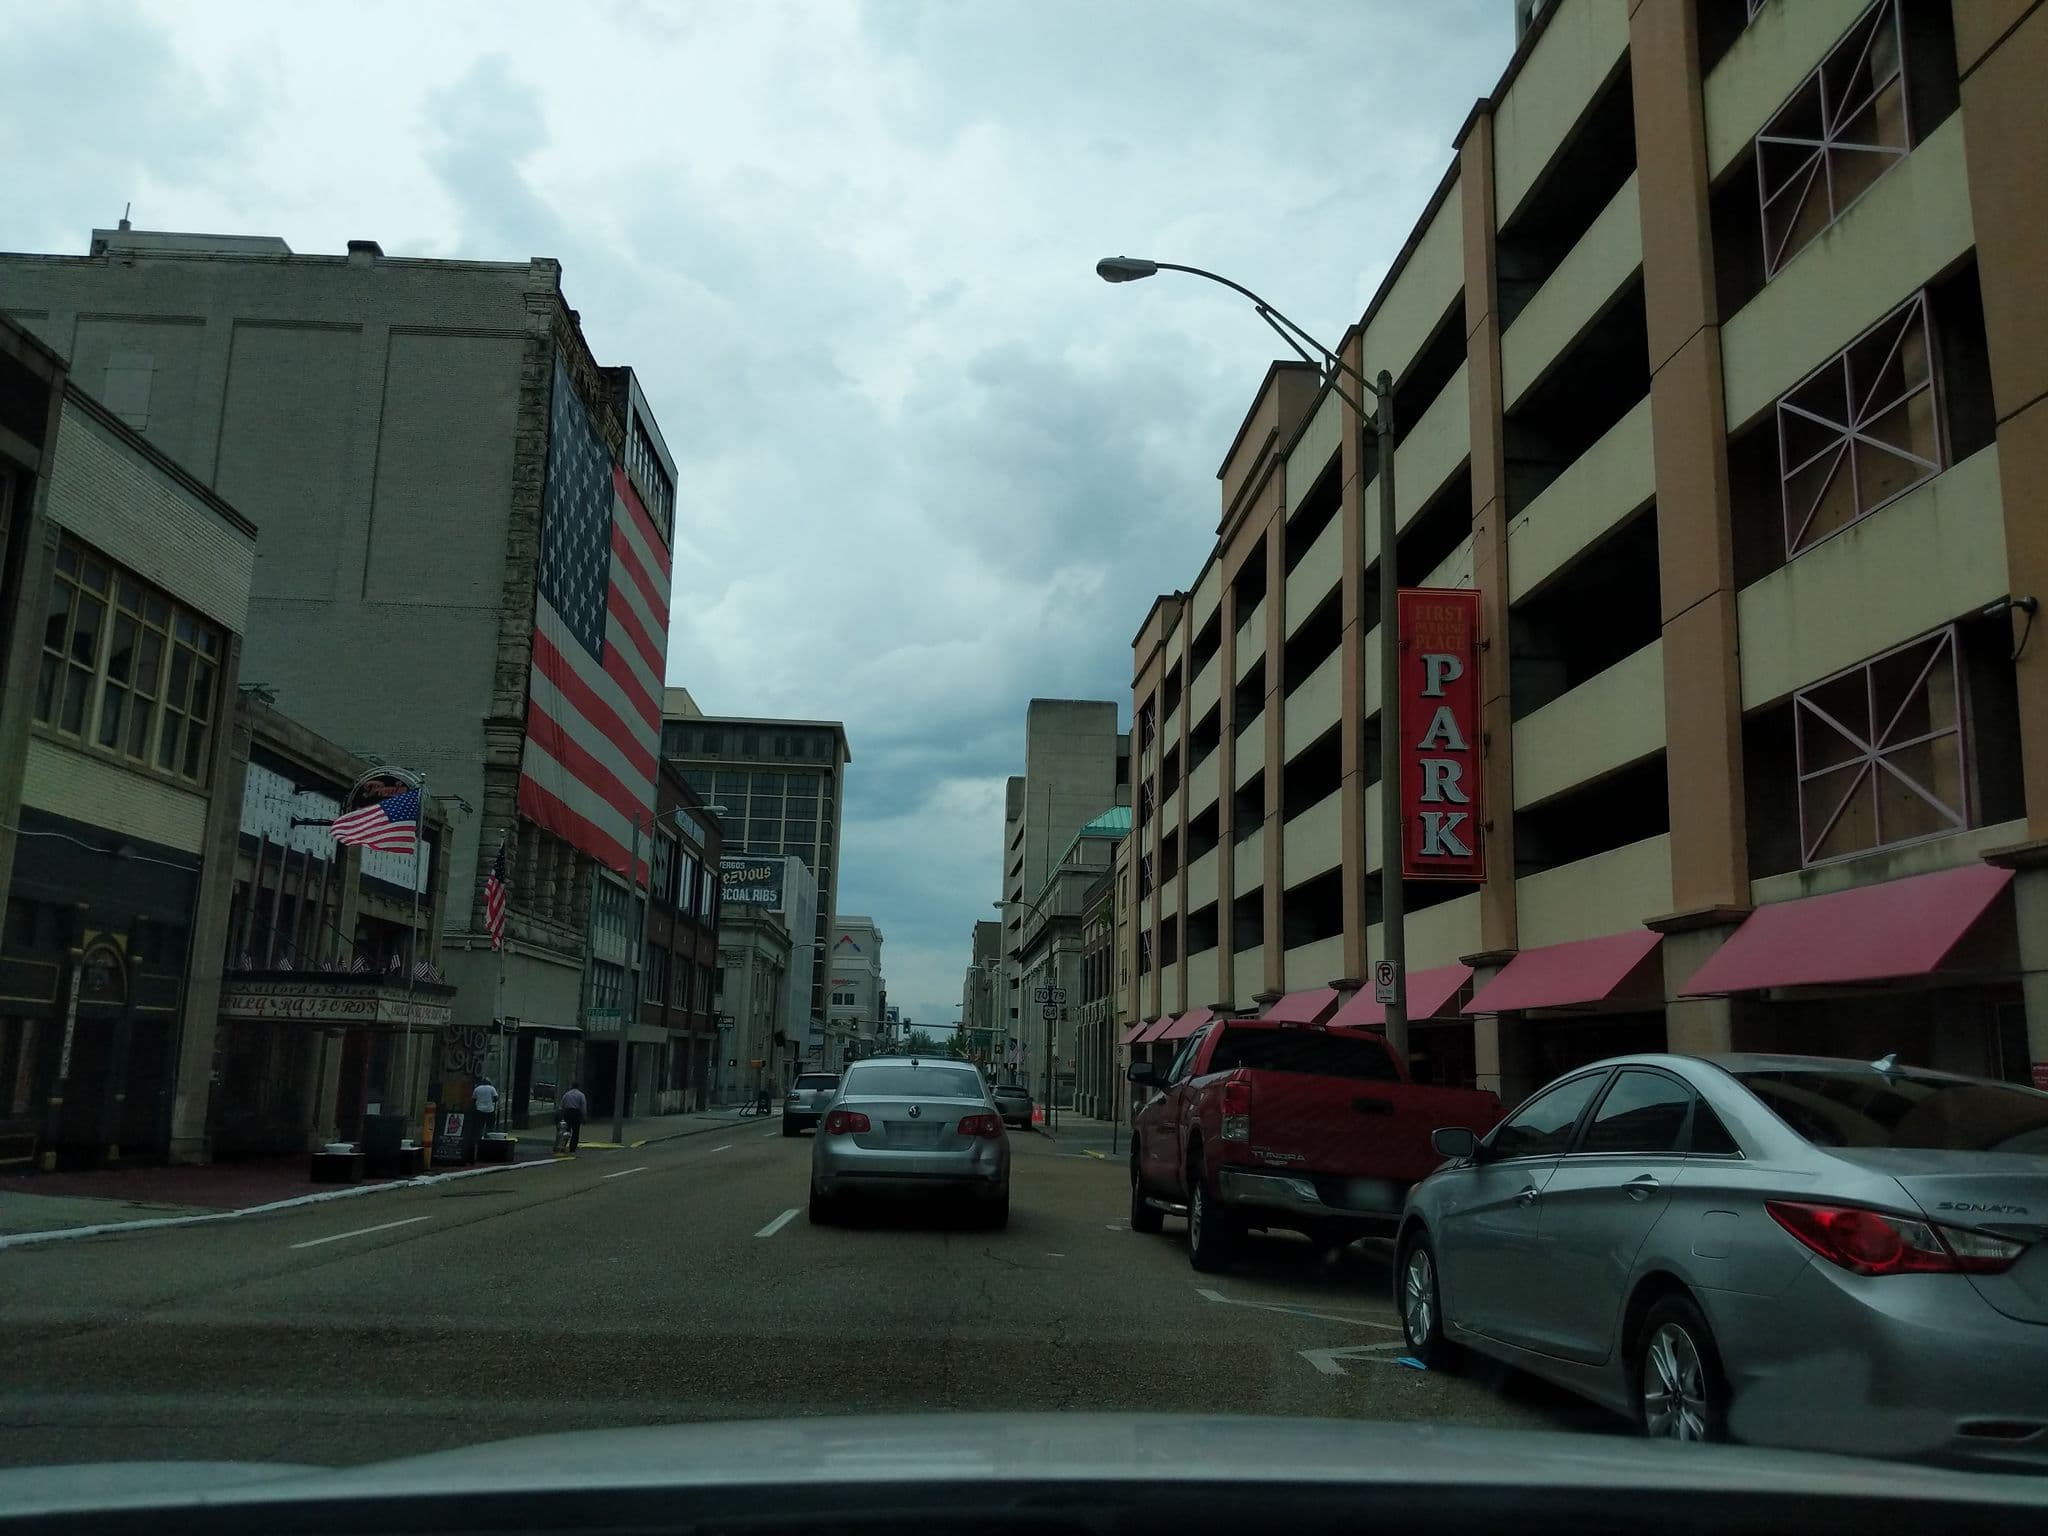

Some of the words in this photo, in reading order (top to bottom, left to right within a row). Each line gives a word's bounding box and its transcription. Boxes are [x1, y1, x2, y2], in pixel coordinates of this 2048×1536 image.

[1415, 605, 1465, 621] FIRST
[1415, 634, 1465, 650] PLACE
[1417, 653, 1473, 856] PARK
[752, 889, 777, 902] RIBS
[1036, 990, 1048, 1000] 70
[1053, 991, 1065, 1001] 79
[1251, 1150, 1306, 1161] TUNDRA
[1936, 1201, 2028, 1215] SONATA
